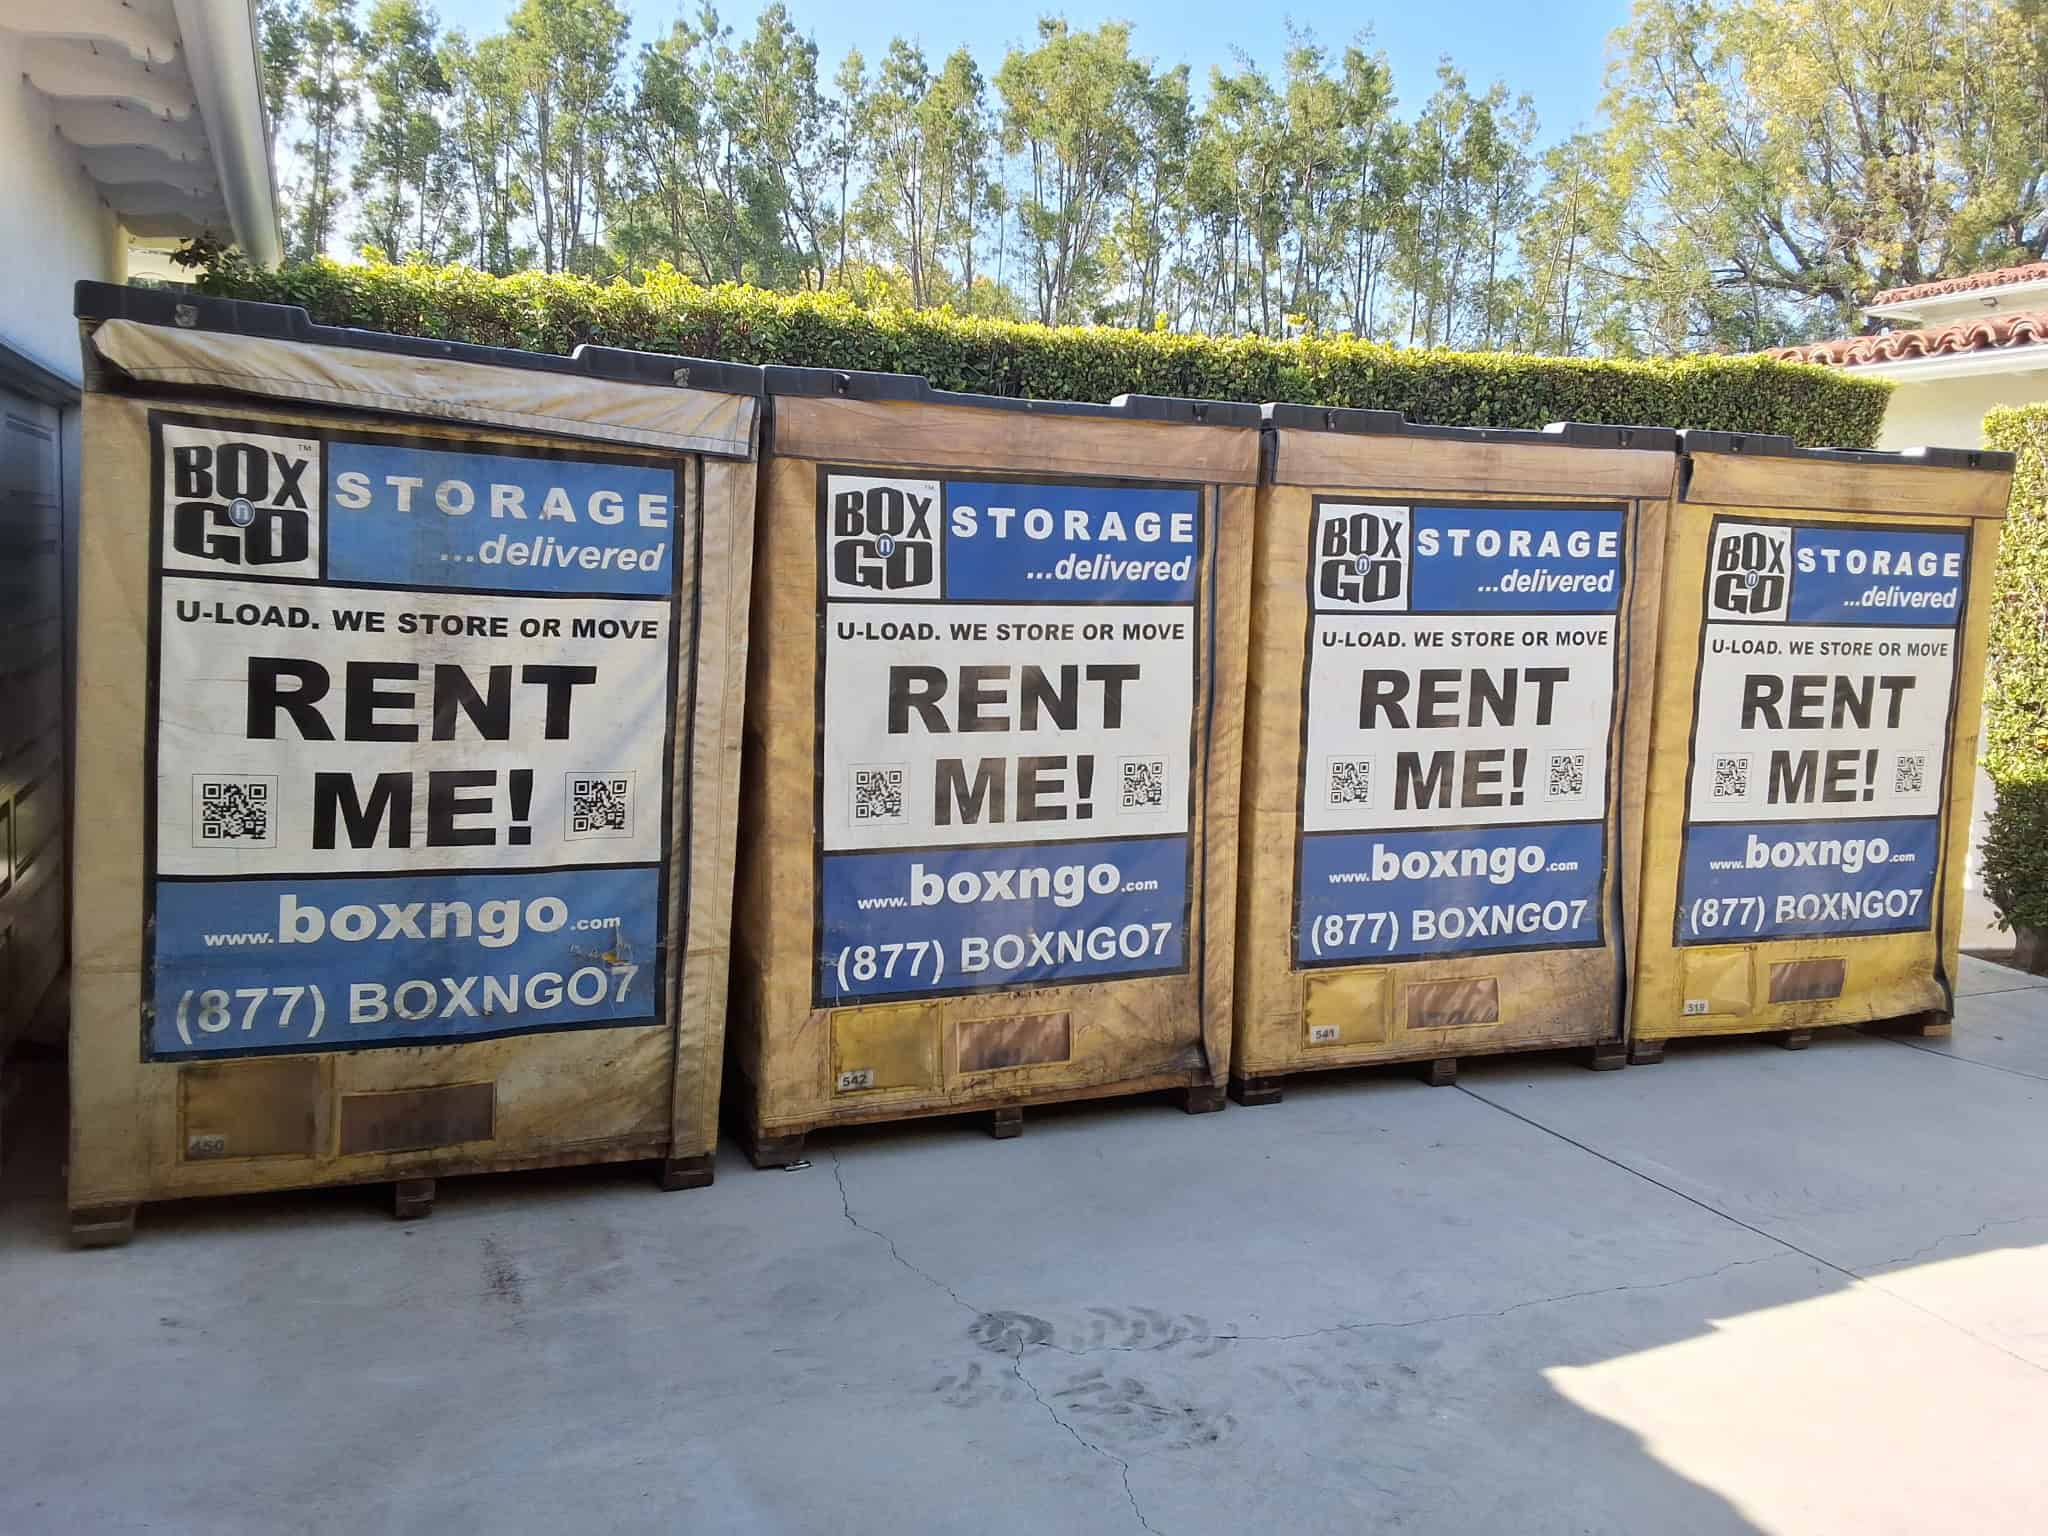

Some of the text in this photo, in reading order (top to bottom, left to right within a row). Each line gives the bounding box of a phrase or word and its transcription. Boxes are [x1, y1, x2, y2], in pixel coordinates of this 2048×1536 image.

[173, 443, 309, 509] BOX
[335, 472, 669, 528] STORAGE
[835, 487, 932, 540] BOX
[174, 502, 309, 565] GO
[951, 506, 1194, 543] STORAGE
[1322, 513, 1402, 558] BOX
[1417, 529, 1617, 557] STORAGE
[441, 534, 664, 571] ...delivered
[834, 539, 933, 591] GO
[1025, 554, 1191, 581] ...delivered
[1717, 532, 1785, 574] BOX
[1798, 547, 1960, 577] STORAGE
[1320, 559, 1402, 604] GO
[1478, 568, 1614, 593] ...delivered
[1714, 574, 1785, 614] GO
[1844, 585, 1957, 608] ...delivered
[177, 600, 658, 639] U-LOAD. WE STORE OR MOVE
[837, 621, 1185, 641] U-LOAD. WE STORE OR MOVE
[1322, 630, 1608, 648] U-LOAD. WE STORE OR MOVE
[1712, 640, 1948, 657] U-LOAD. WE STORE OR MOVE
[246, 657, 598, 742] RENT
[888, 664, 1140, 734] RENT
[1359, 667, 1570, 730] RENT
[1740, 674, 1917, 729] RENT
[934, 754, 1095, 826] ME!
[1393, 748, 1528, 810] ME!
[1767, 749, 1879, 805] ME!
[313, 769, 534, 849] ME!
[1329, 843, 1578, 885] www.boxngo.com
[1710, 835, 1915, 873] www.boxngo.com
[857, 862, 1158, 910] www.boxngo.com
[204, 893, 621, 947] www.boxngo.com
[1311, 900, 1587, 956] (877) BOXNGO7
[1691, 889, 1923, 934] (877) BOXNGO7
[837, 922, 1173, 991] (877) BOXNGO7
[176, 964, 640, 1045] (877) BOXNGO7
[842, 1073, 868, 1087] 542
